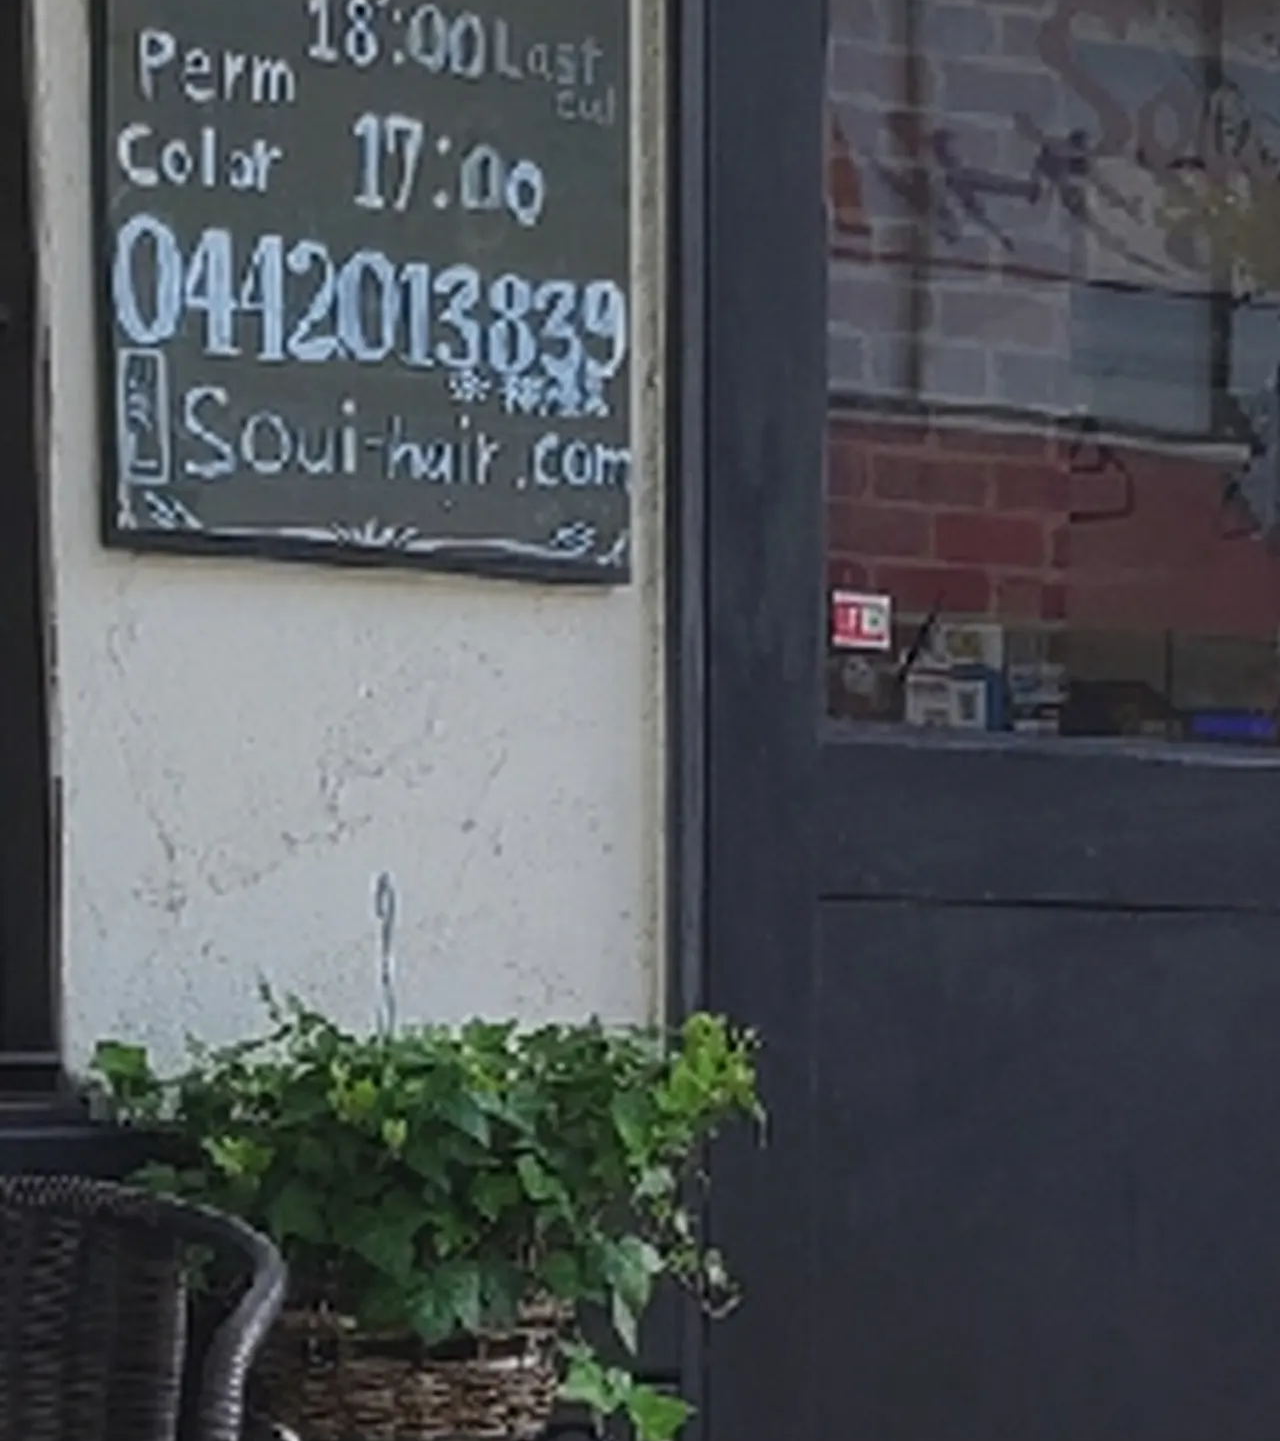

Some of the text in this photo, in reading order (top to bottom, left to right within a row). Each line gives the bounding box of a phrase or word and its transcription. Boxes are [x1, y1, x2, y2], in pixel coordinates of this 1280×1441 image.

[138, 27, 295, 102] Perm
[354, 112, 544, 226] 17:00
[112, 213, 626, 378] 0442013839
